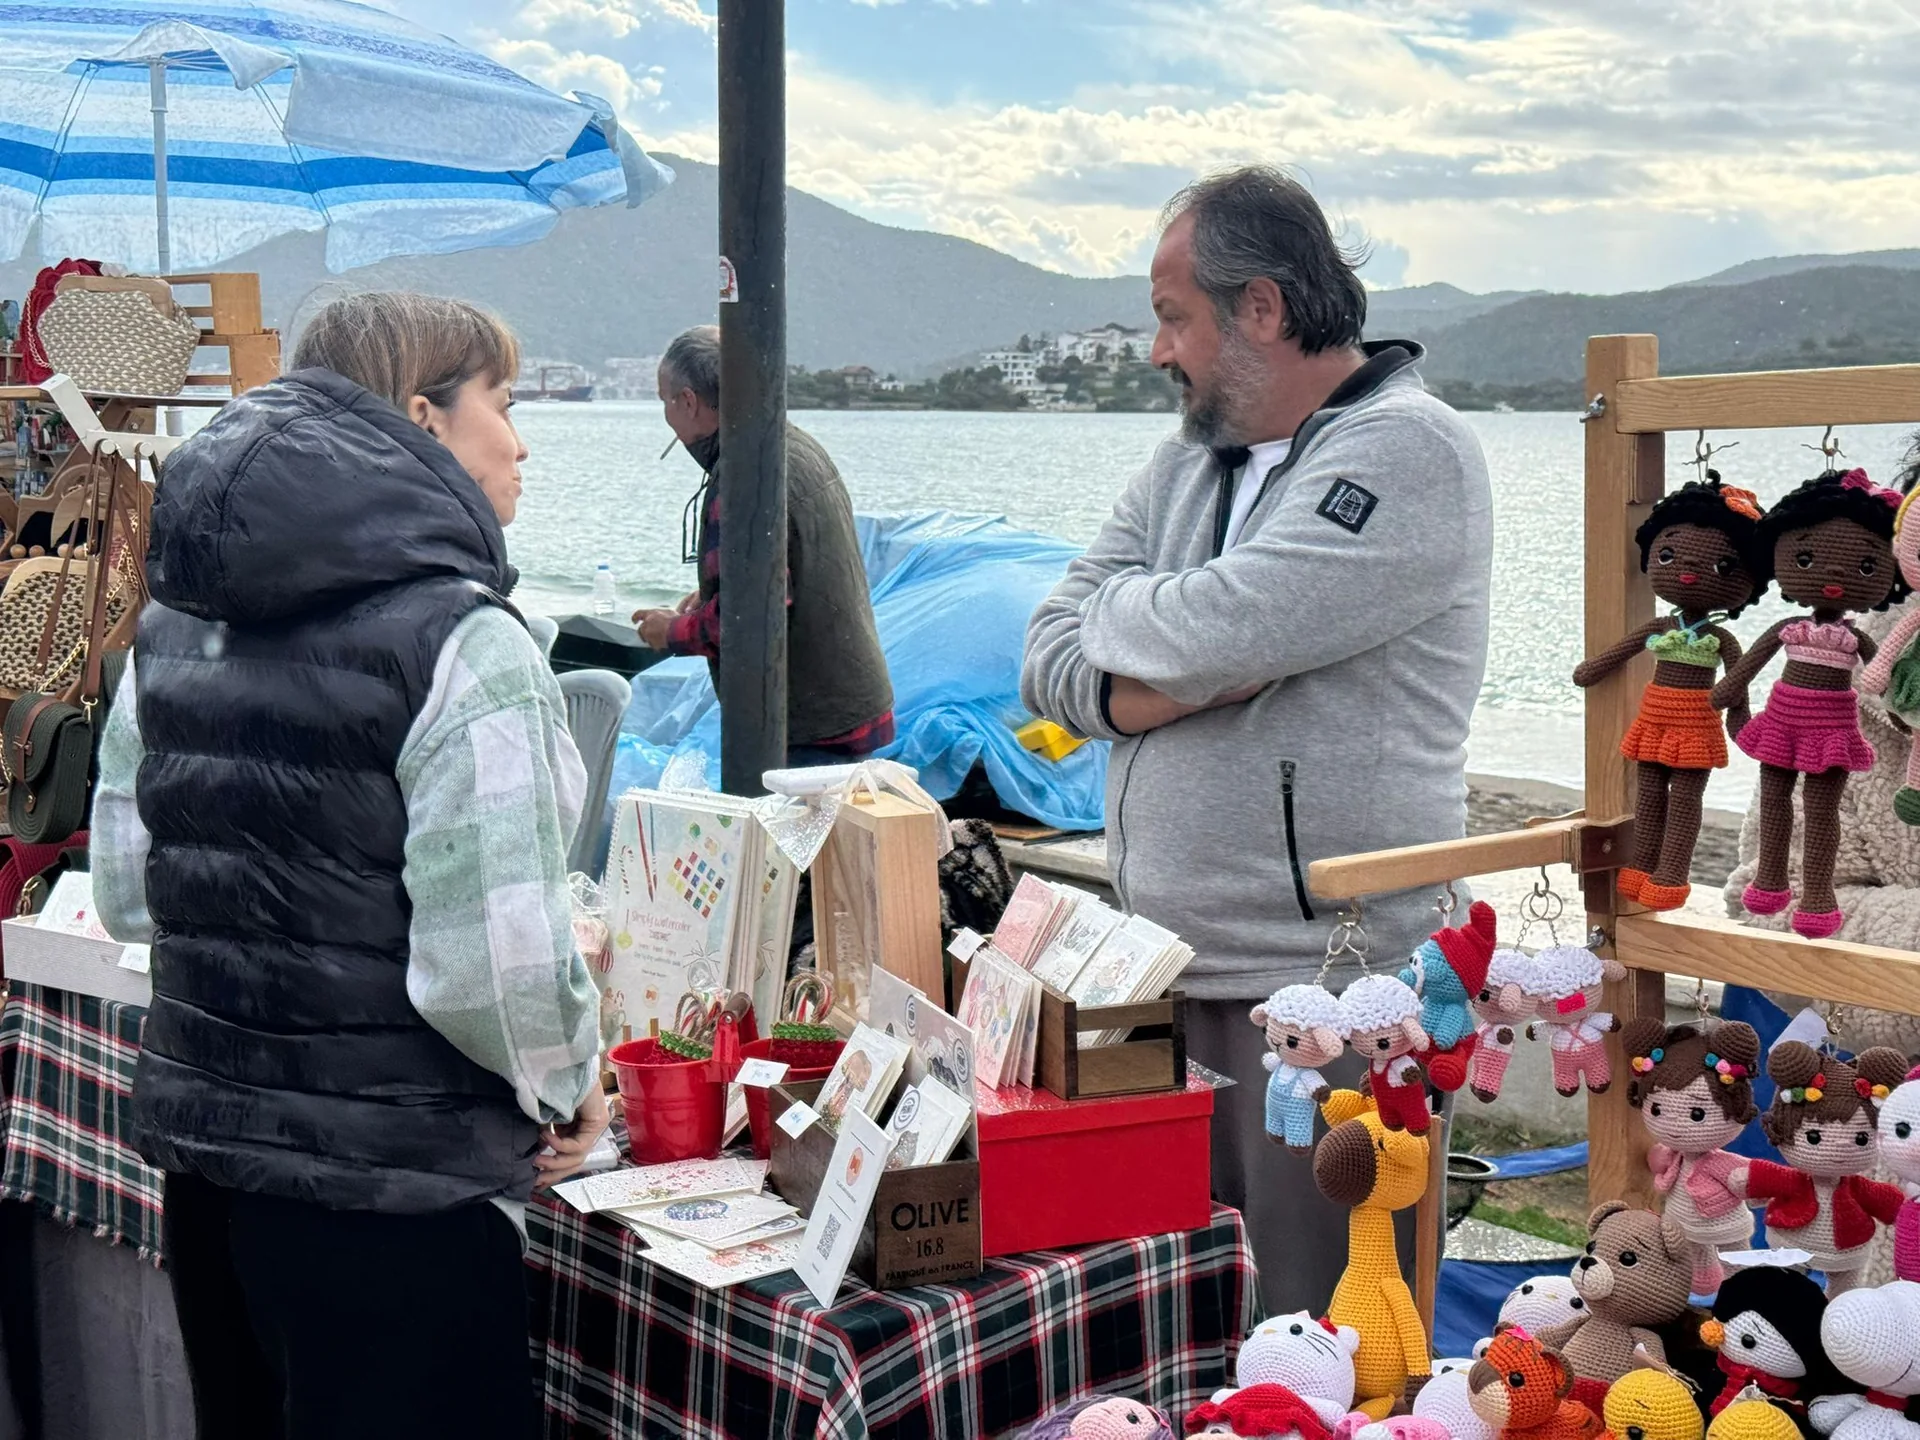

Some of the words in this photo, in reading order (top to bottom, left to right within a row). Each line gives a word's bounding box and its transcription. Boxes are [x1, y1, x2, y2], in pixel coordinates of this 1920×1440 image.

[891, 1198, 969, 1231] OLIVE
[916, 1236, 944, 1258] 16.8
[928, 1267, 940, 1275] en
[941, 1260, 975, 1273] FRANCE
